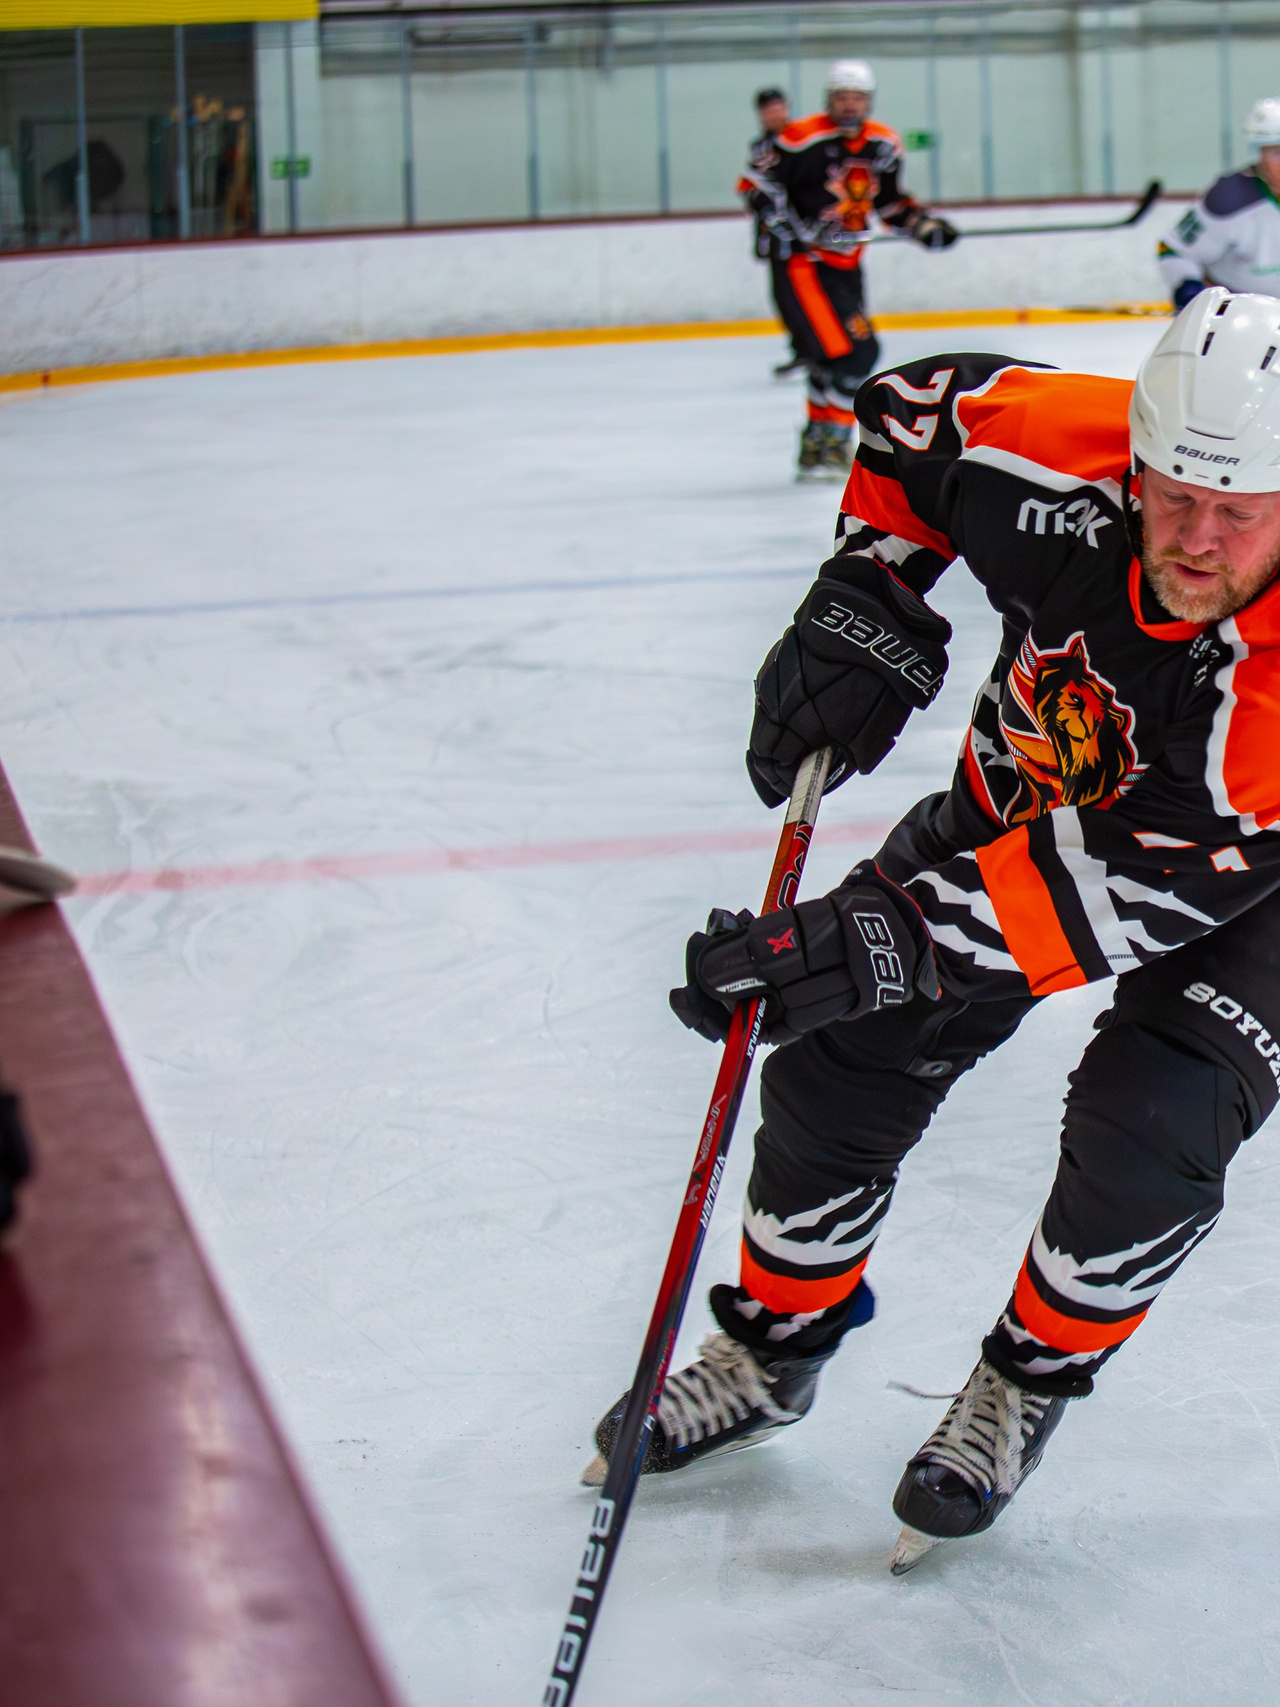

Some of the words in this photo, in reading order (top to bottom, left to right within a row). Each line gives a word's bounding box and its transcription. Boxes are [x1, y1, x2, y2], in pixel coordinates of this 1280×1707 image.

[874, 366, 956, 451] 77
[1173, 444, 1241, 467] BAUER
[852, 911, 906, 1009] BAU
